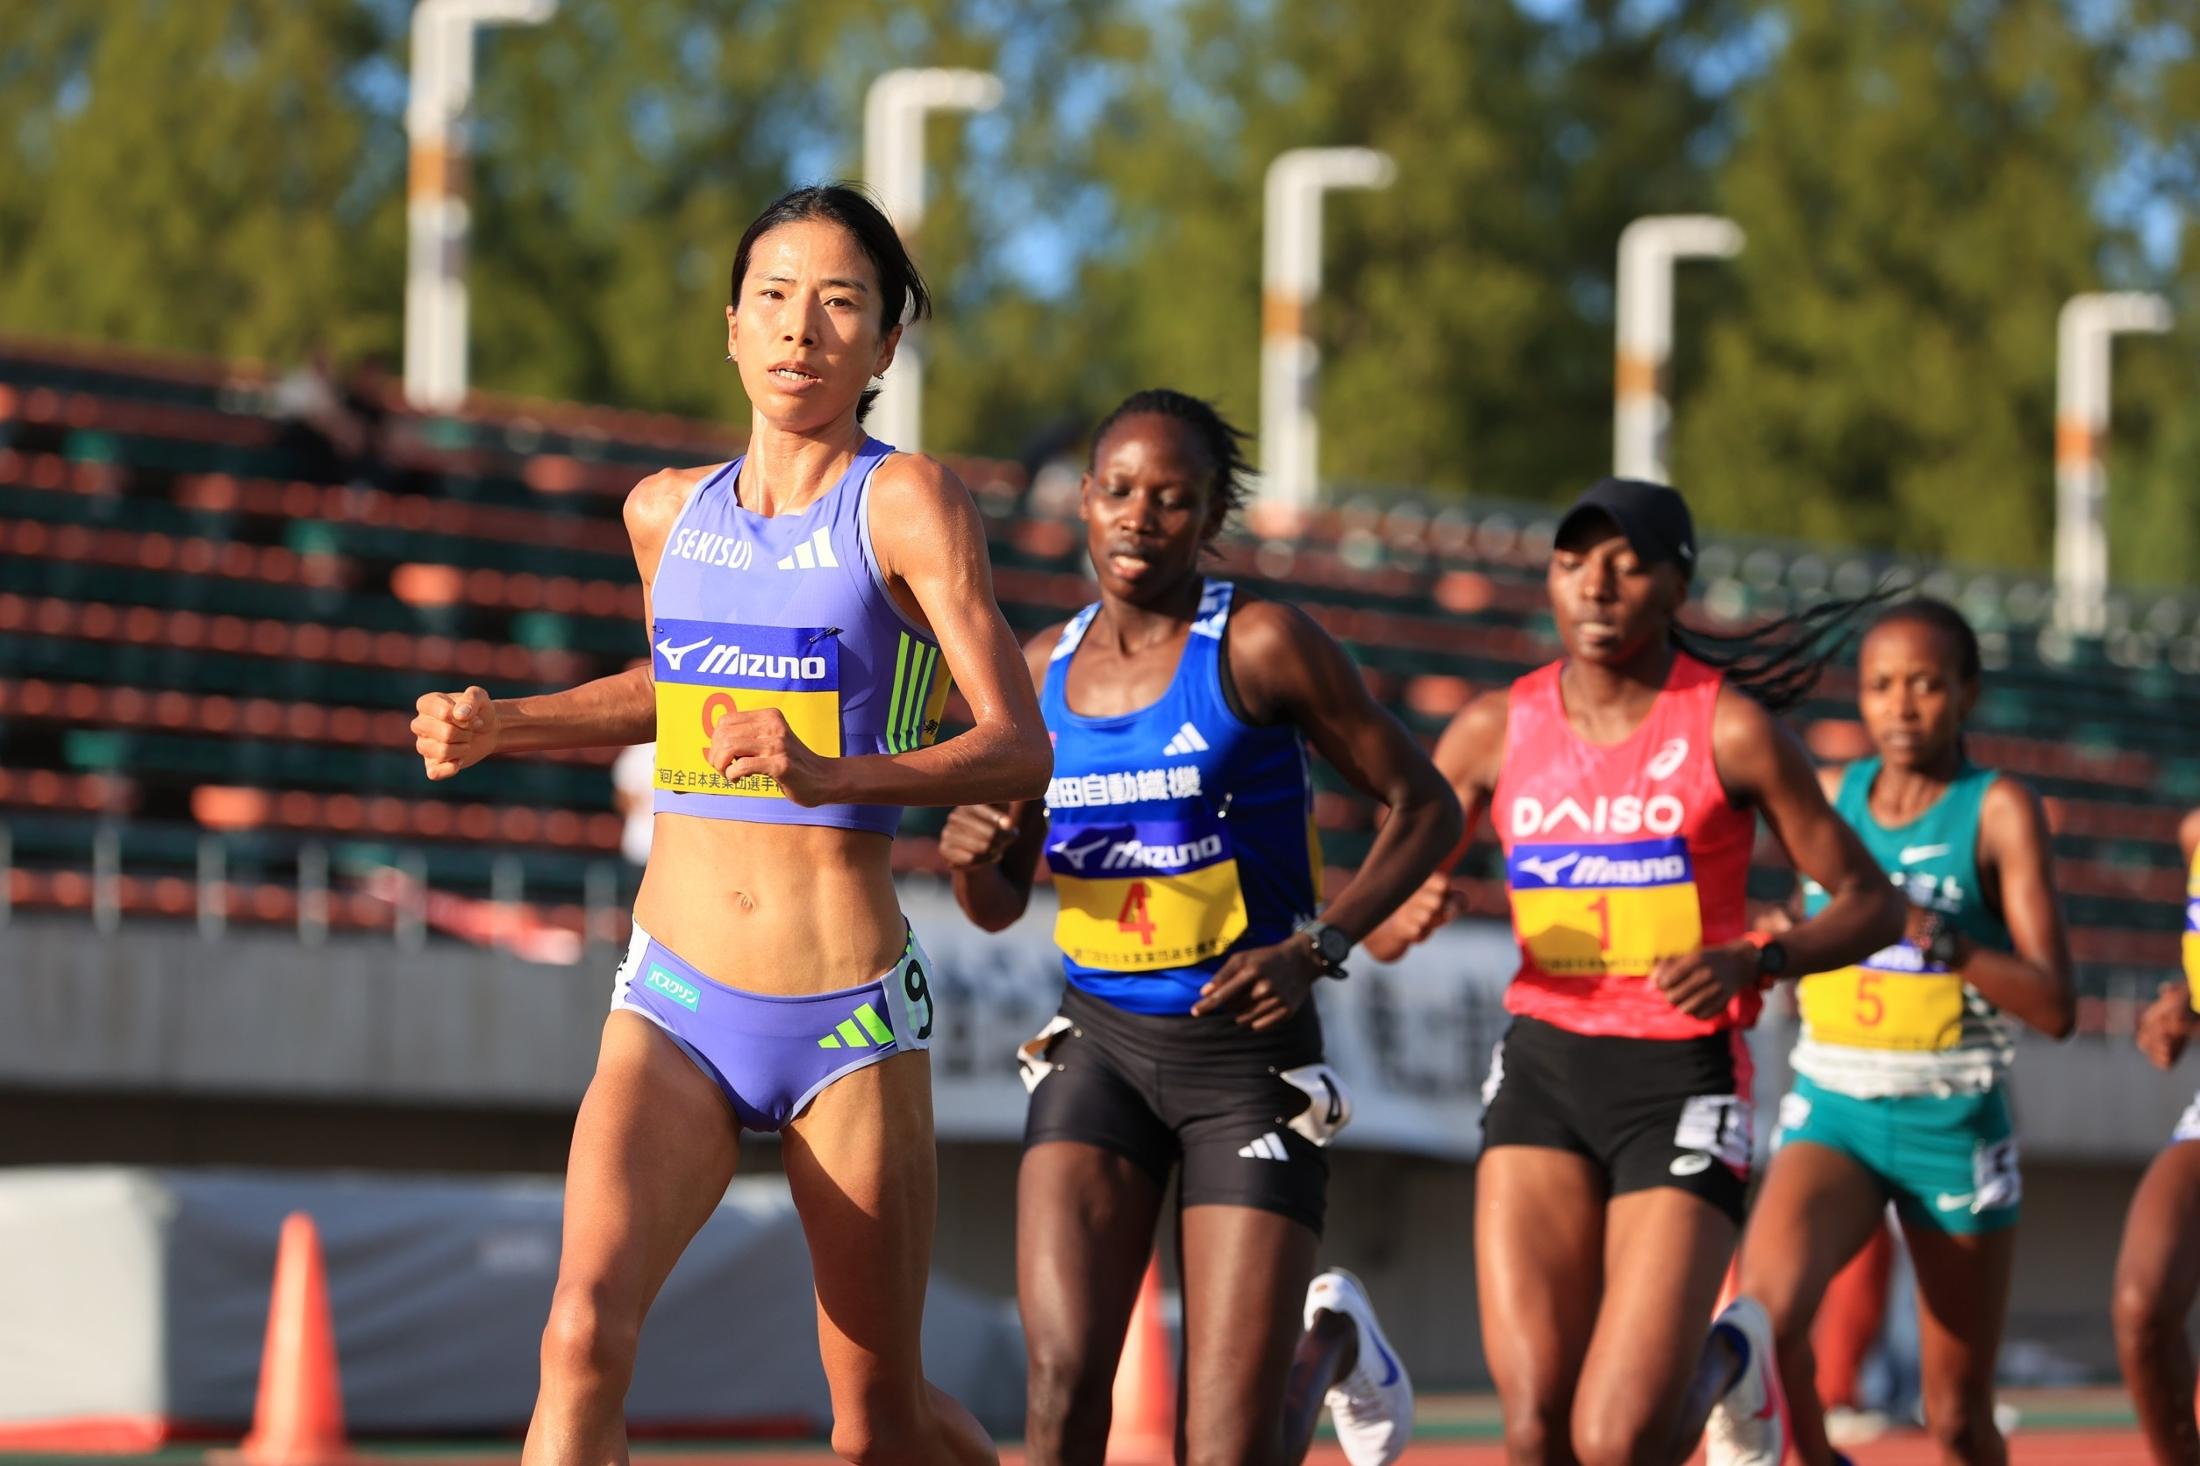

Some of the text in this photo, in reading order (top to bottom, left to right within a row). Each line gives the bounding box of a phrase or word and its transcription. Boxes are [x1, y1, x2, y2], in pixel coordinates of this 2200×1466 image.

[671, 528, 752, 571] SEKISUI
[1512, 794, 1685, 837] DAISO
[1118, 880, 1157, 945] 4
[1587, 895, 1610, 952] 1
[648, 970, 698, 1004] パスクリン
[905, 959, 933, 1039] 9
[1855, 976, 1885, 1028] 5
